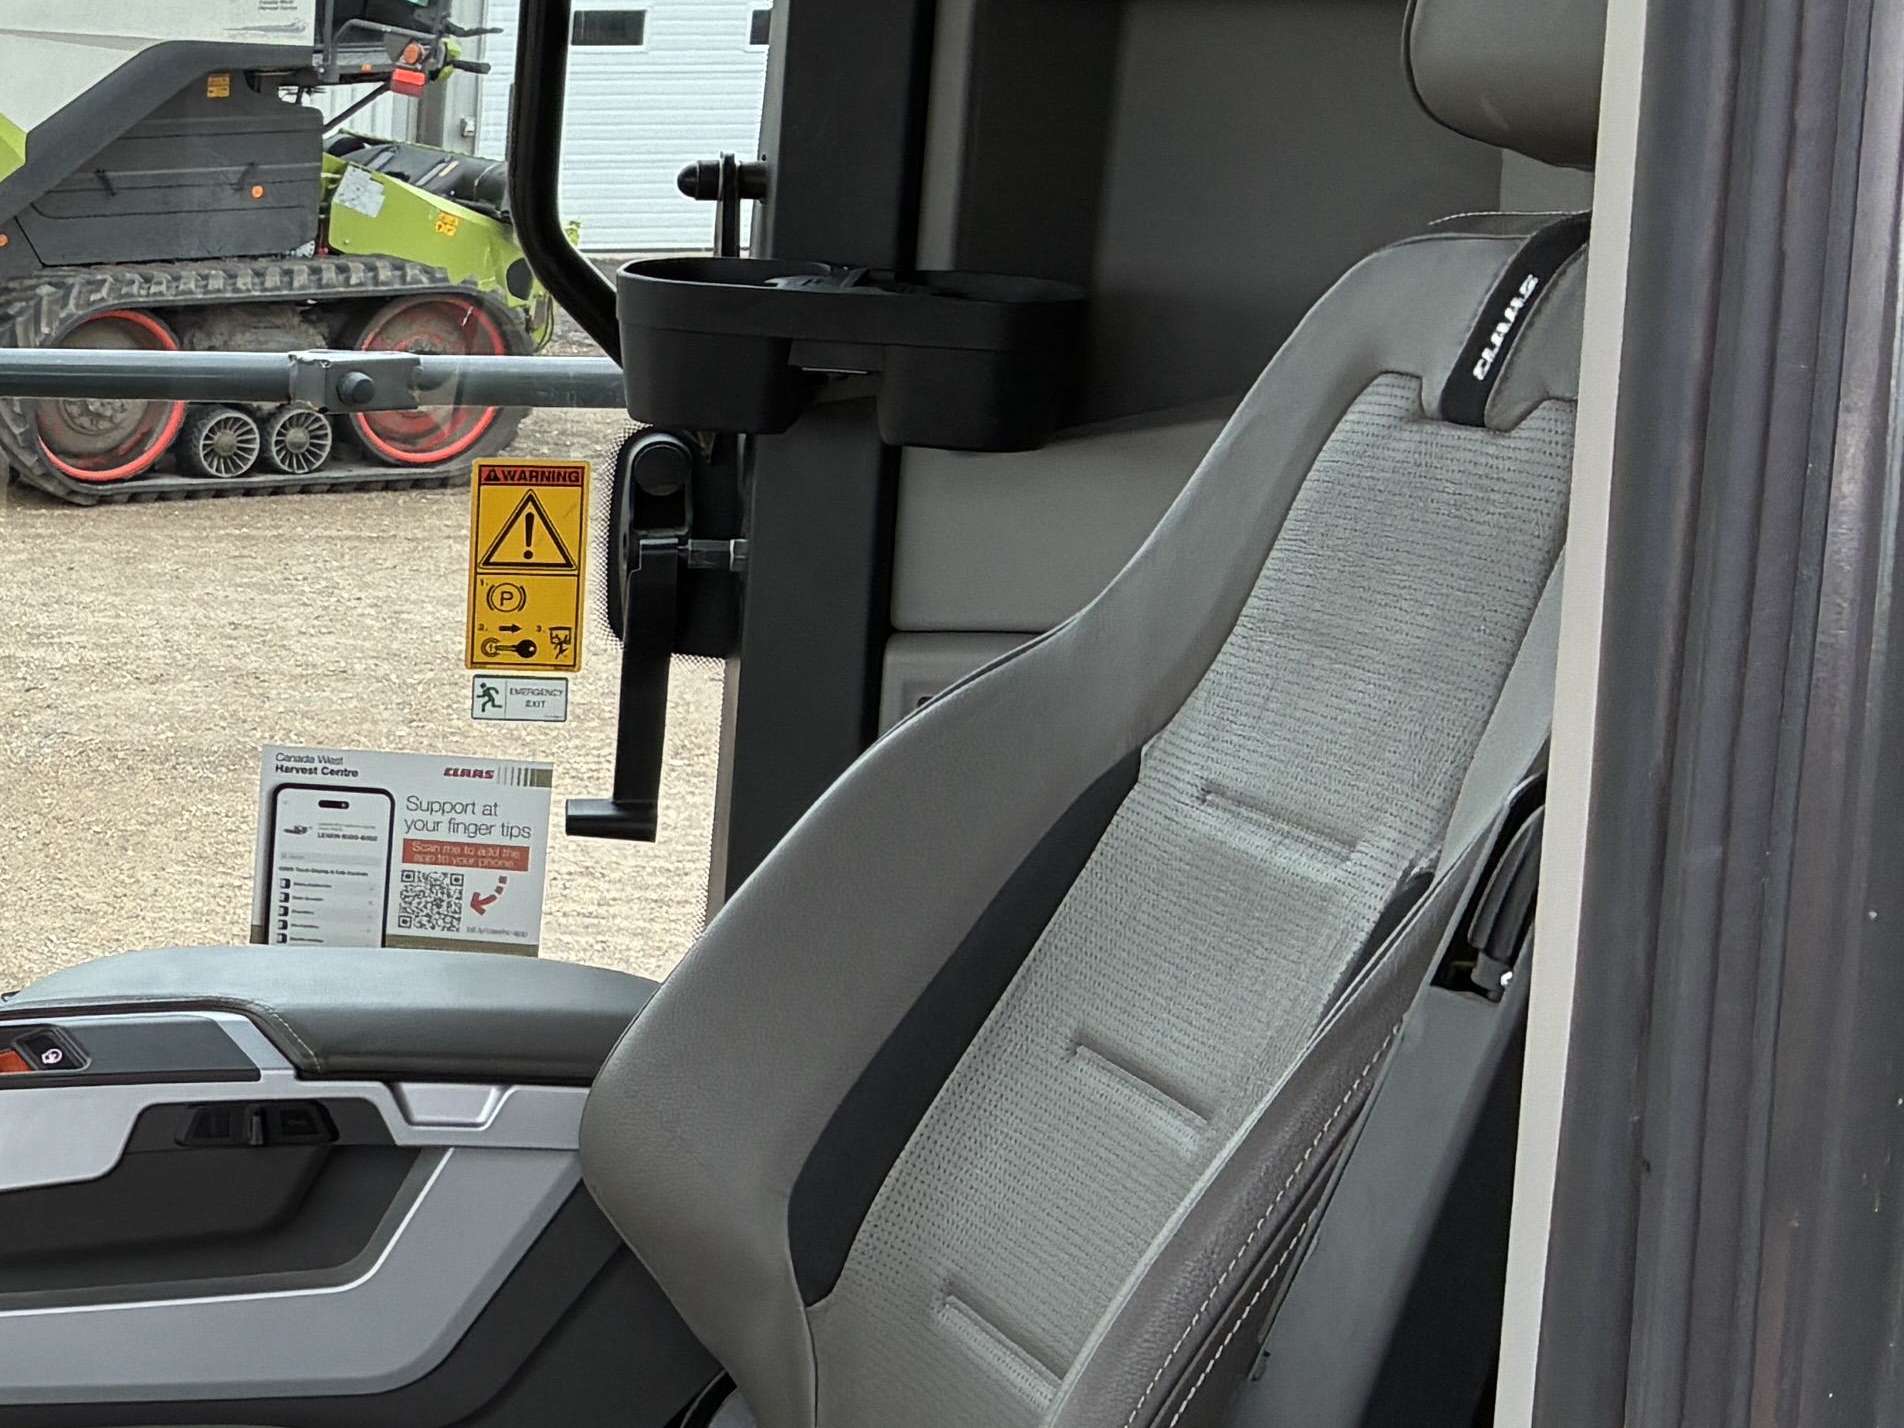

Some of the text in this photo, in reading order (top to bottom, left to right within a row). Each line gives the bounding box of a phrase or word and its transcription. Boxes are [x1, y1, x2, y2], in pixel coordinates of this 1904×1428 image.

[1472, 273, 1539, 382] CLAAS
[502, 470, 581, 483] WARNING
[509, 687, 563, 698] EMERGENCY
[525, 699, 547, 709] EXIT
[275, 763, 359, 778] Harvest Centre
[443, 767, 495, 780] CLAAS
[405, 795, 500, 817] Support at
[404, 817, 532, 840] your finger tips
[412, 841, 441, 854] Scan
